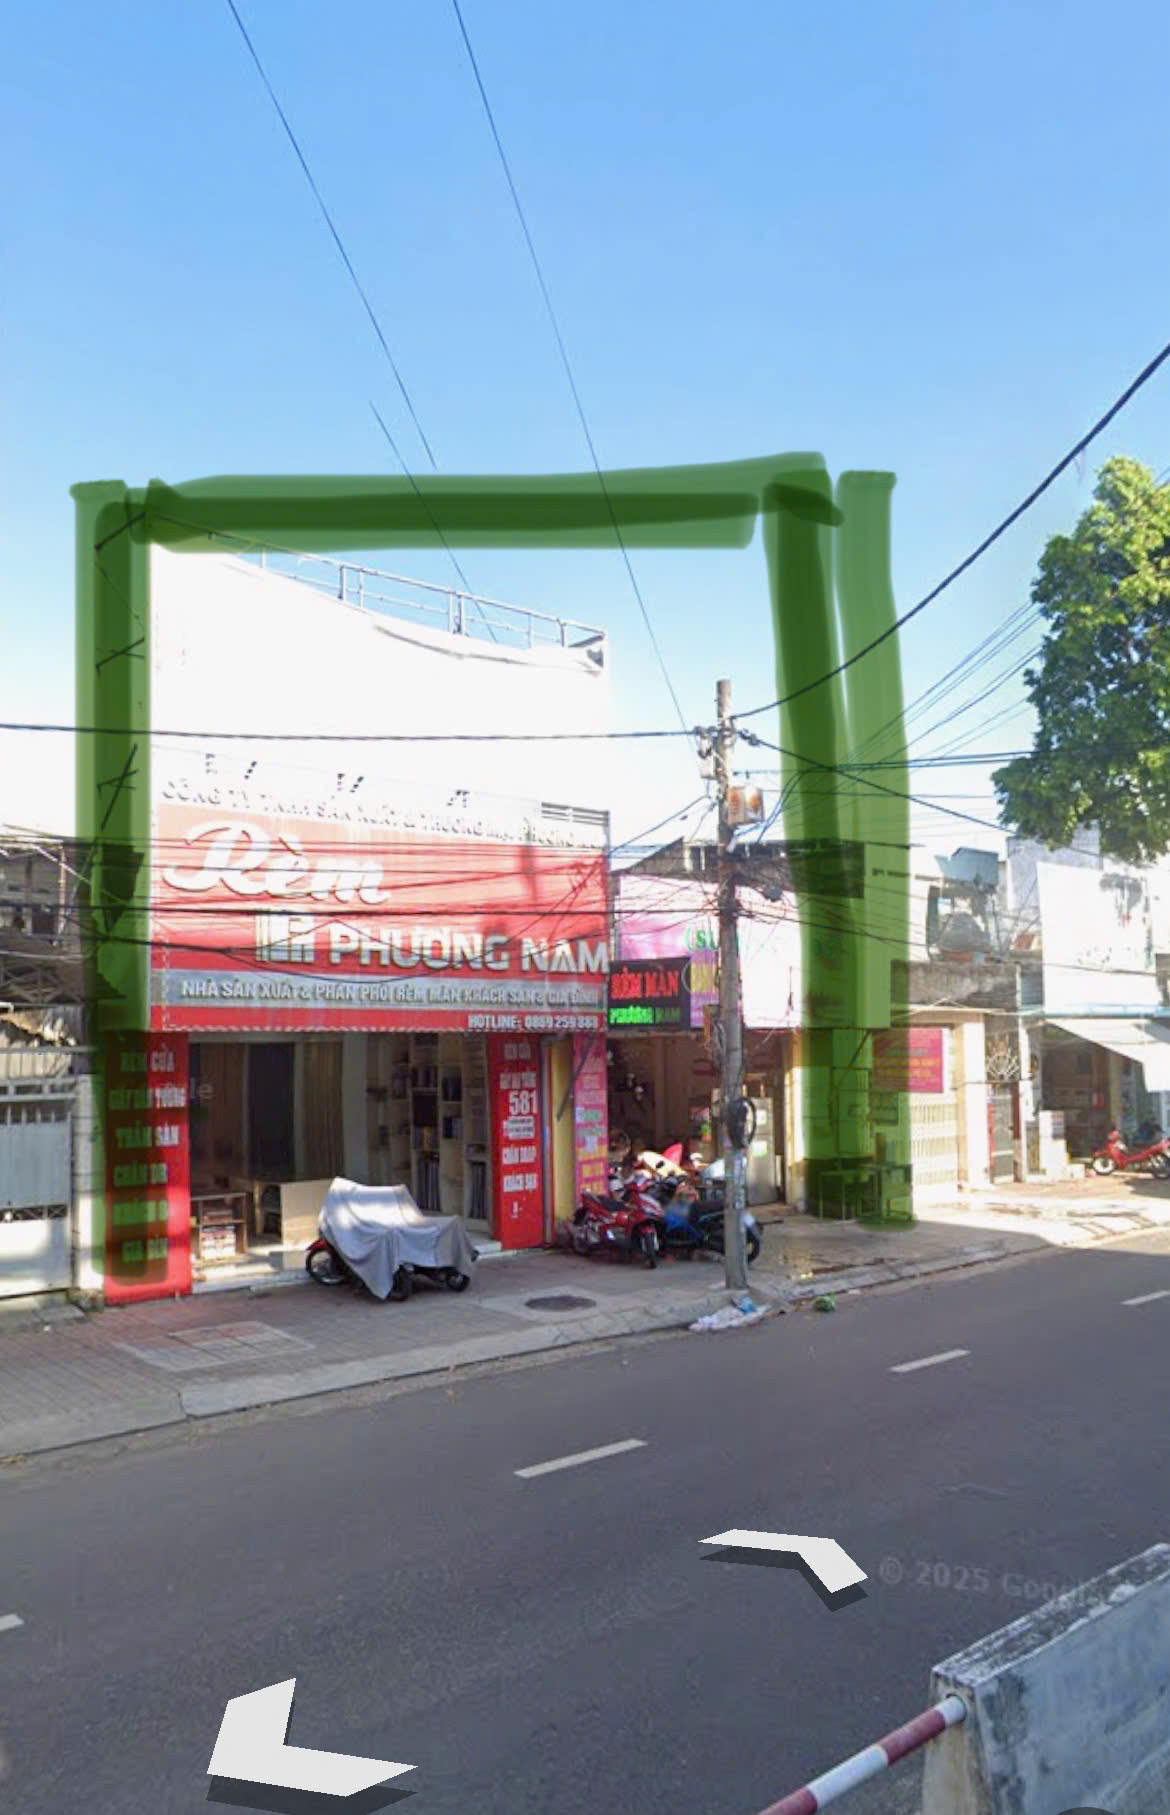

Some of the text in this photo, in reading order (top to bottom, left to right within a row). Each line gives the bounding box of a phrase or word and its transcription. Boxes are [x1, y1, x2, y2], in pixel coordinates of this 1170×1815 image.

[161, 820, 392, 905] Rèm
[522, 936, 609, 974] NAM
[468, 1013, 520, 1028] HOTLINE:
[509, 1090, 537, 1116] 581
